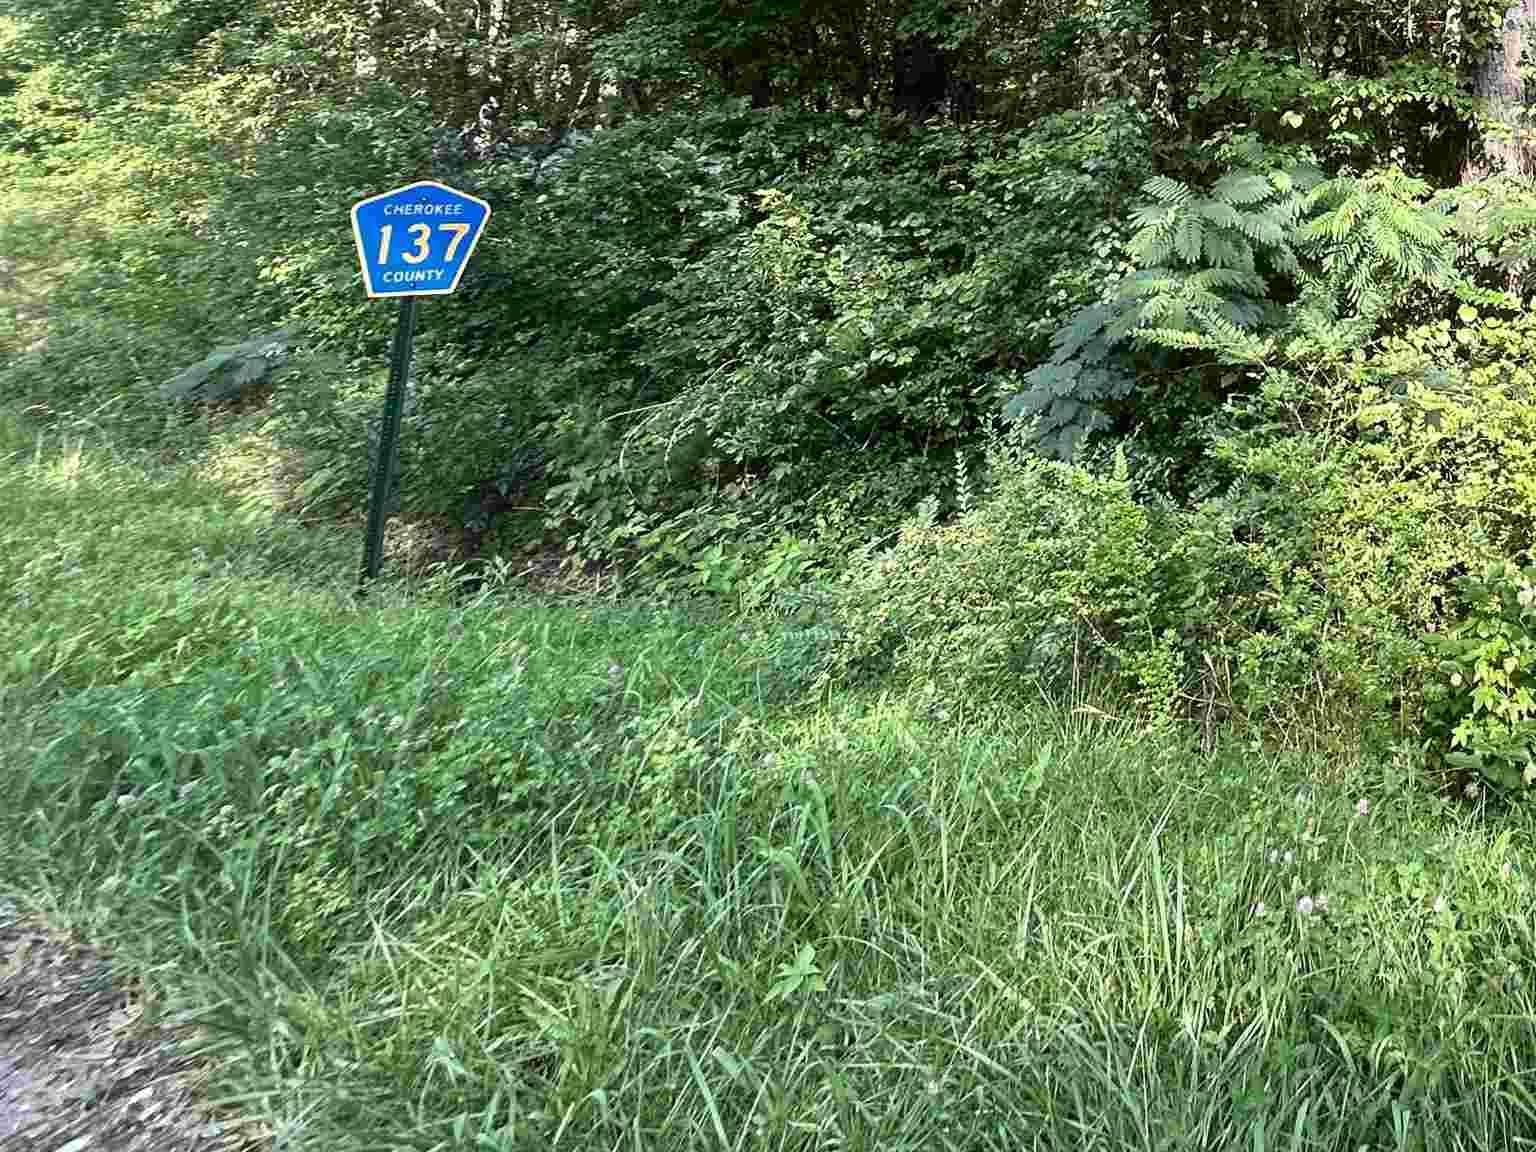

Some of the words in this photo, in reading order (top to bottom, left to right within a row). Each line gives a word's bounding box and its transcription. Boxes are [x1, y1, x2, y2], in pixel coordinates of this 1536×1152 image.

[383, 203, 464, 216] CHEROKEE
[378, 223, 470, 264] 137
[383, 268, 444, 282] COUNTY
